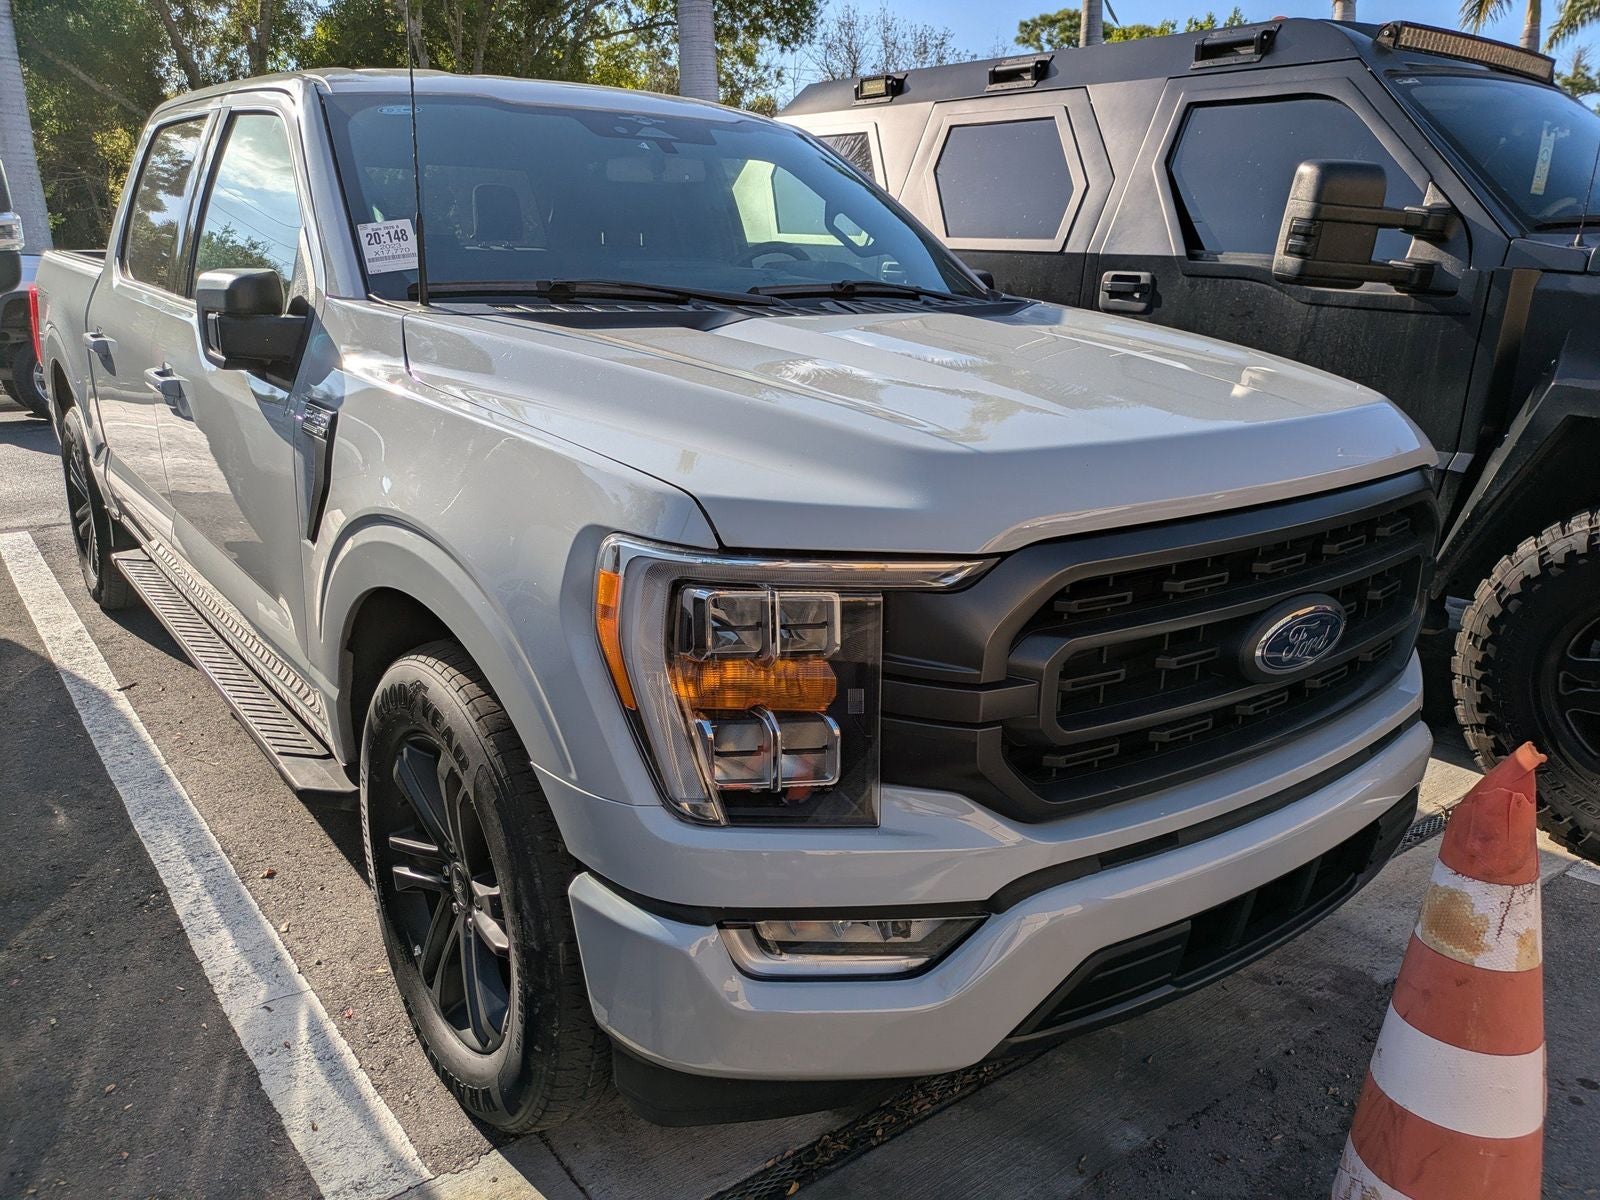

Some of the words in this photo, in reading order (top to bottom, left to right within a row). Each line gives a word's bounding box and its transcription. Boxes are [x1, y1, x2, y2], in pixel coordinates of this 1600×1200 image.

[366, 229, 408, 246] 20:148
[1282, 620, 1330, 658] Ford
[374, 681, 470, 774] GOODYEAR
